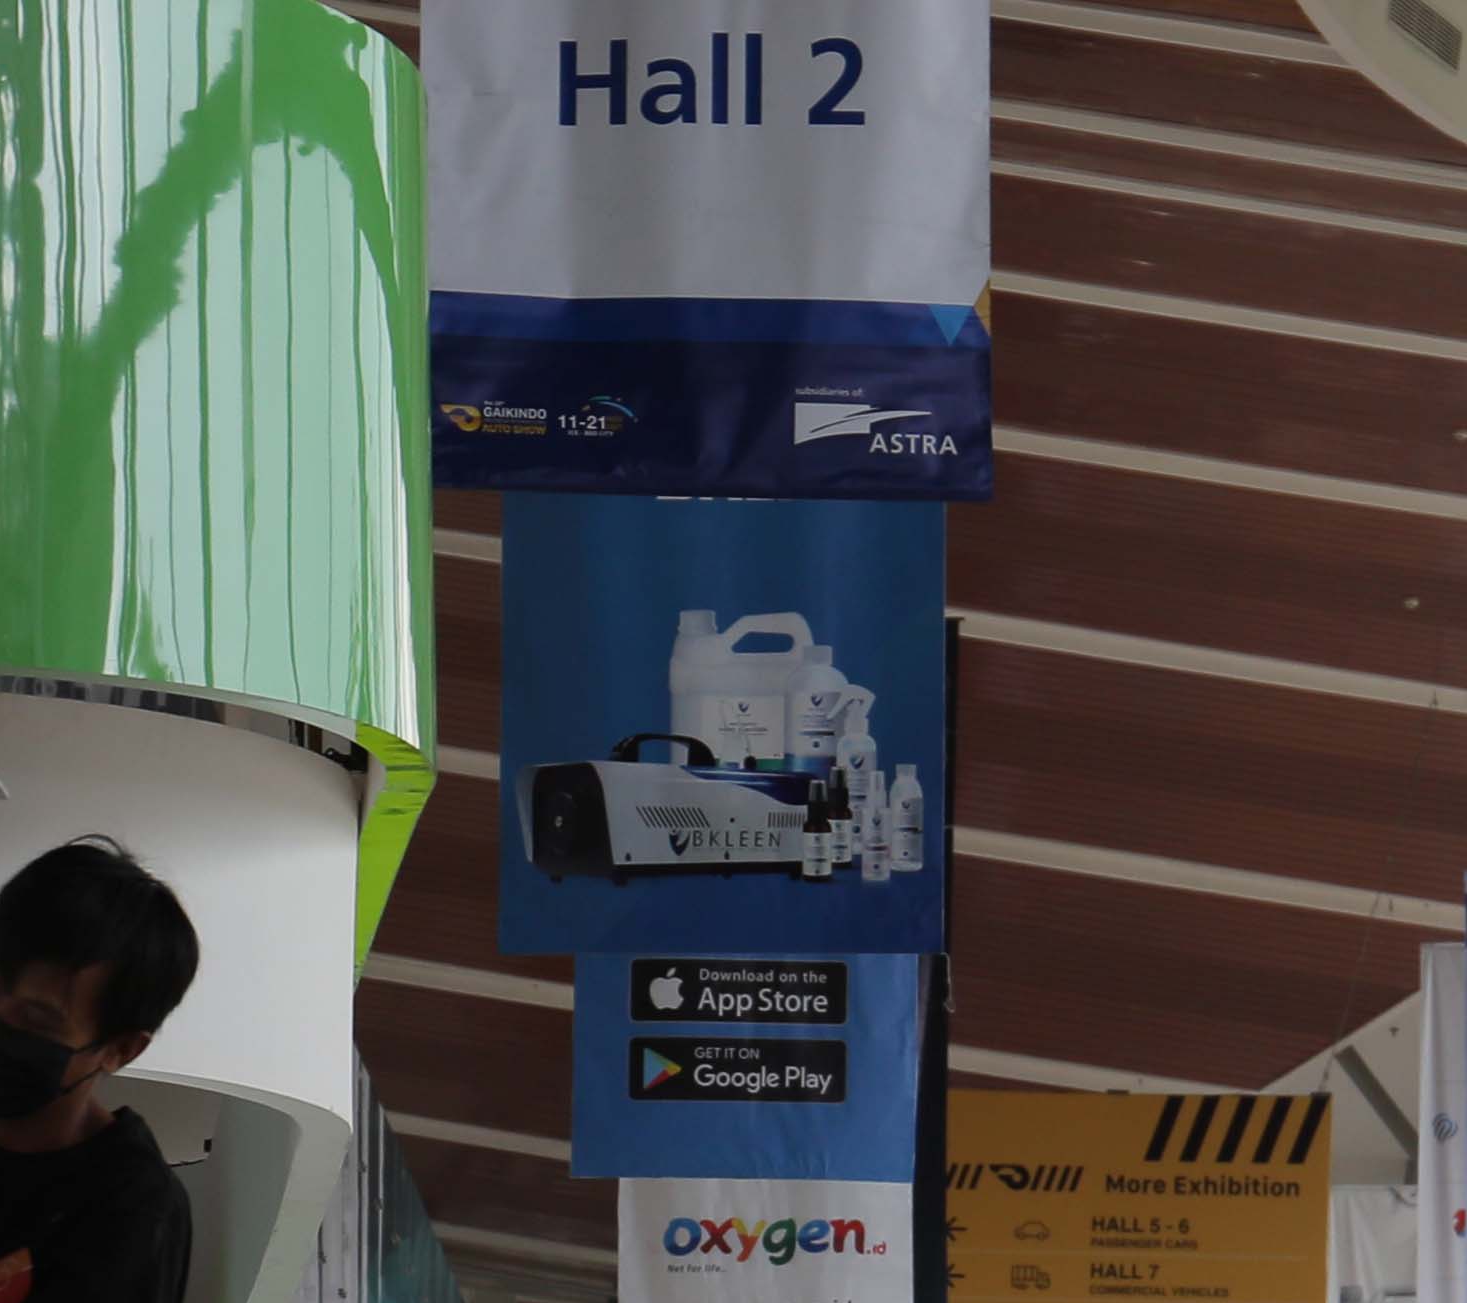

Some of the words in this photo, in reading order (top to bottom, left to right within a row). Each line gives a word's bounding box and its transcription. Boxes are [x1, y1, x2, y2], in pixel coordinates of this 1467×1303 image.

[559, 32, 762, 126] Hall
[808, 37, 865, 126] 2
[483, 406, 547, 419] GAIKINDO
[558, 415, 606, 430] 11-21
[869, 433, 958, 455] ASTRA
[699, 968, 774, 982] Download
[779, 972, 797, 983] on
[803, 970, 827, 984] the
[697, 987, 753, 1017] App
[758, 988, 828, 1013] Store
[694, 1047, 721, 1059] GET
[724, 1047, 737, 1060] IT
[738, 1047, 760, 1060] ON
[693, 1063, 780, 1094] Google
[785, 1066, 832, 1095] Play
[1105, 1174, 1166, 1195] More
[1174, 1176, 1300, 1198] Exhibition
[1091, 1216, 1144, 1234] HALL
[1149, 1218, 1160, 1234] 5
[1179, 1218, 1190, 1234] 6
[1090, 1237, 1161, 1249] PASSENGER
[1090, 1263, 1143, 1279] HALL
[1148, 1264, 1160, 1280] 7
[1089, 1284, 1167, 1297] COMMERCIAL
[1171, 1286, 1230, 1298] VEHICLES
